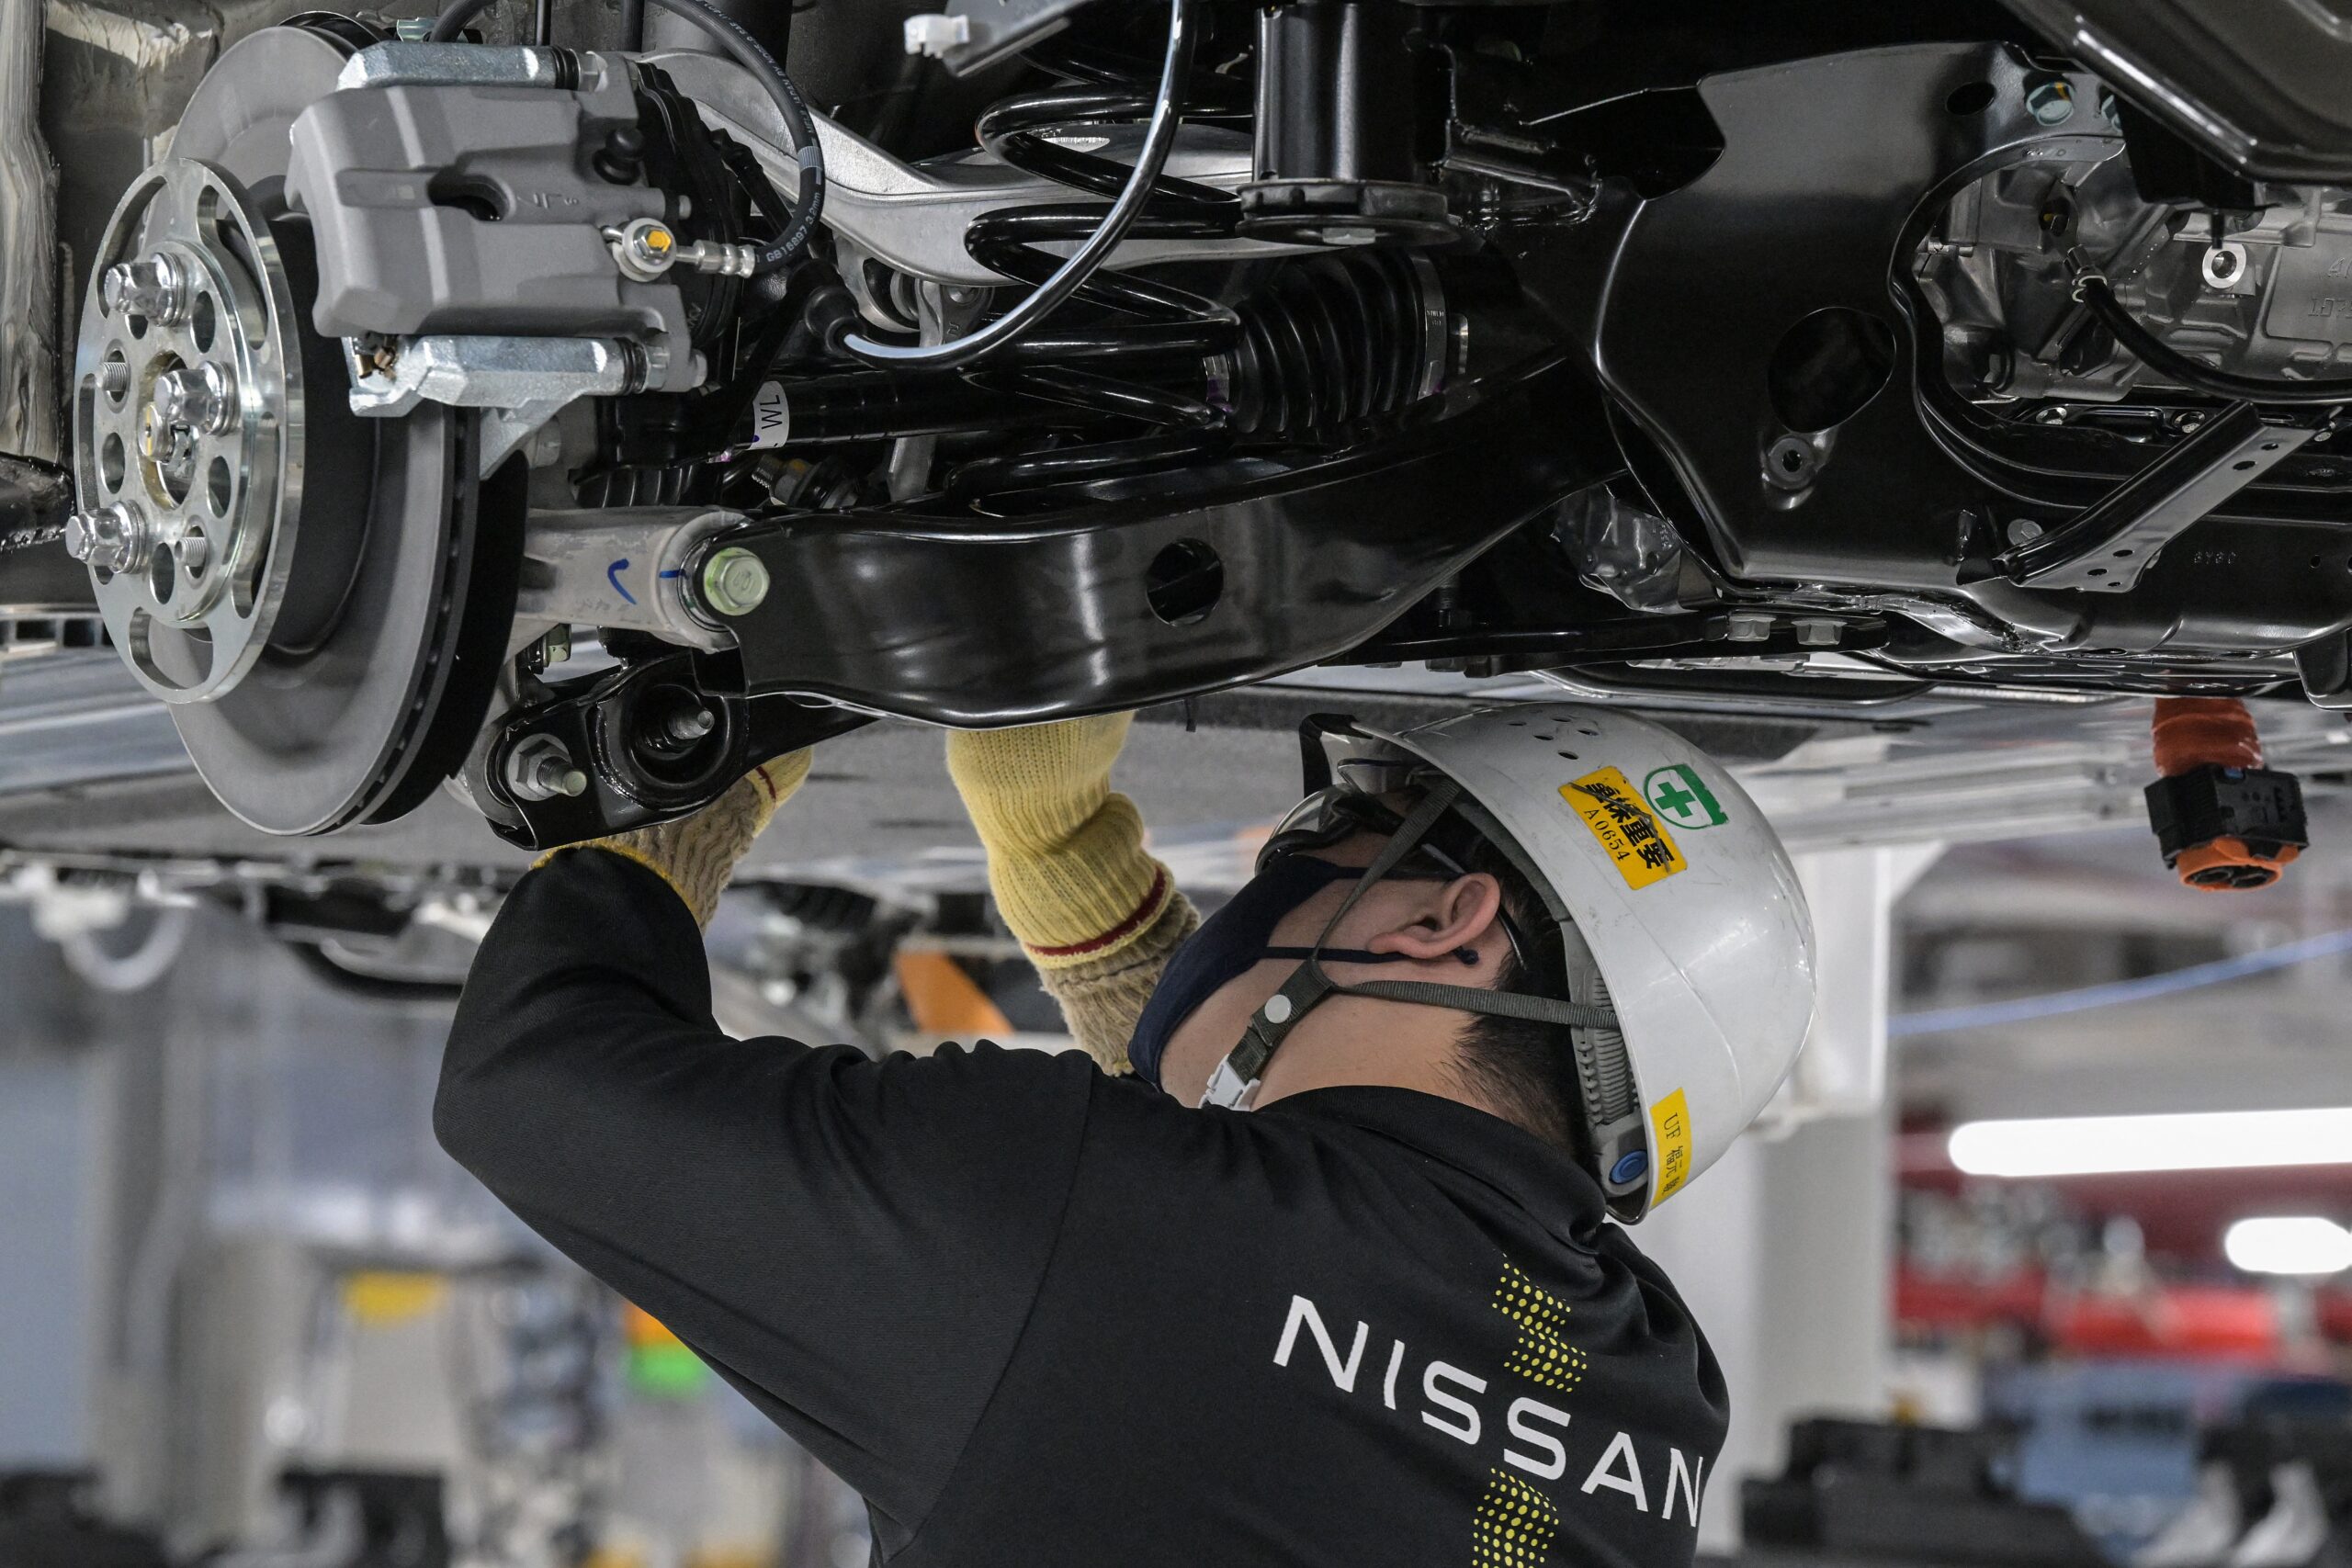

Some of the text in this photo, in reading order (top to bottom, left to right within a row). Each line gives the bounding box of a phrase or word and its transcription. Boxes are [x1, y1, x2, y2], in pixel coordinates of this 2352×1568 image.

[759, 394, 783, 430] WL
[1583, 807, 1631, 862] A0654
[1663, 1111, 1681, 1140] UF
[1272, 1294, 1703, 1528] NISSAN
